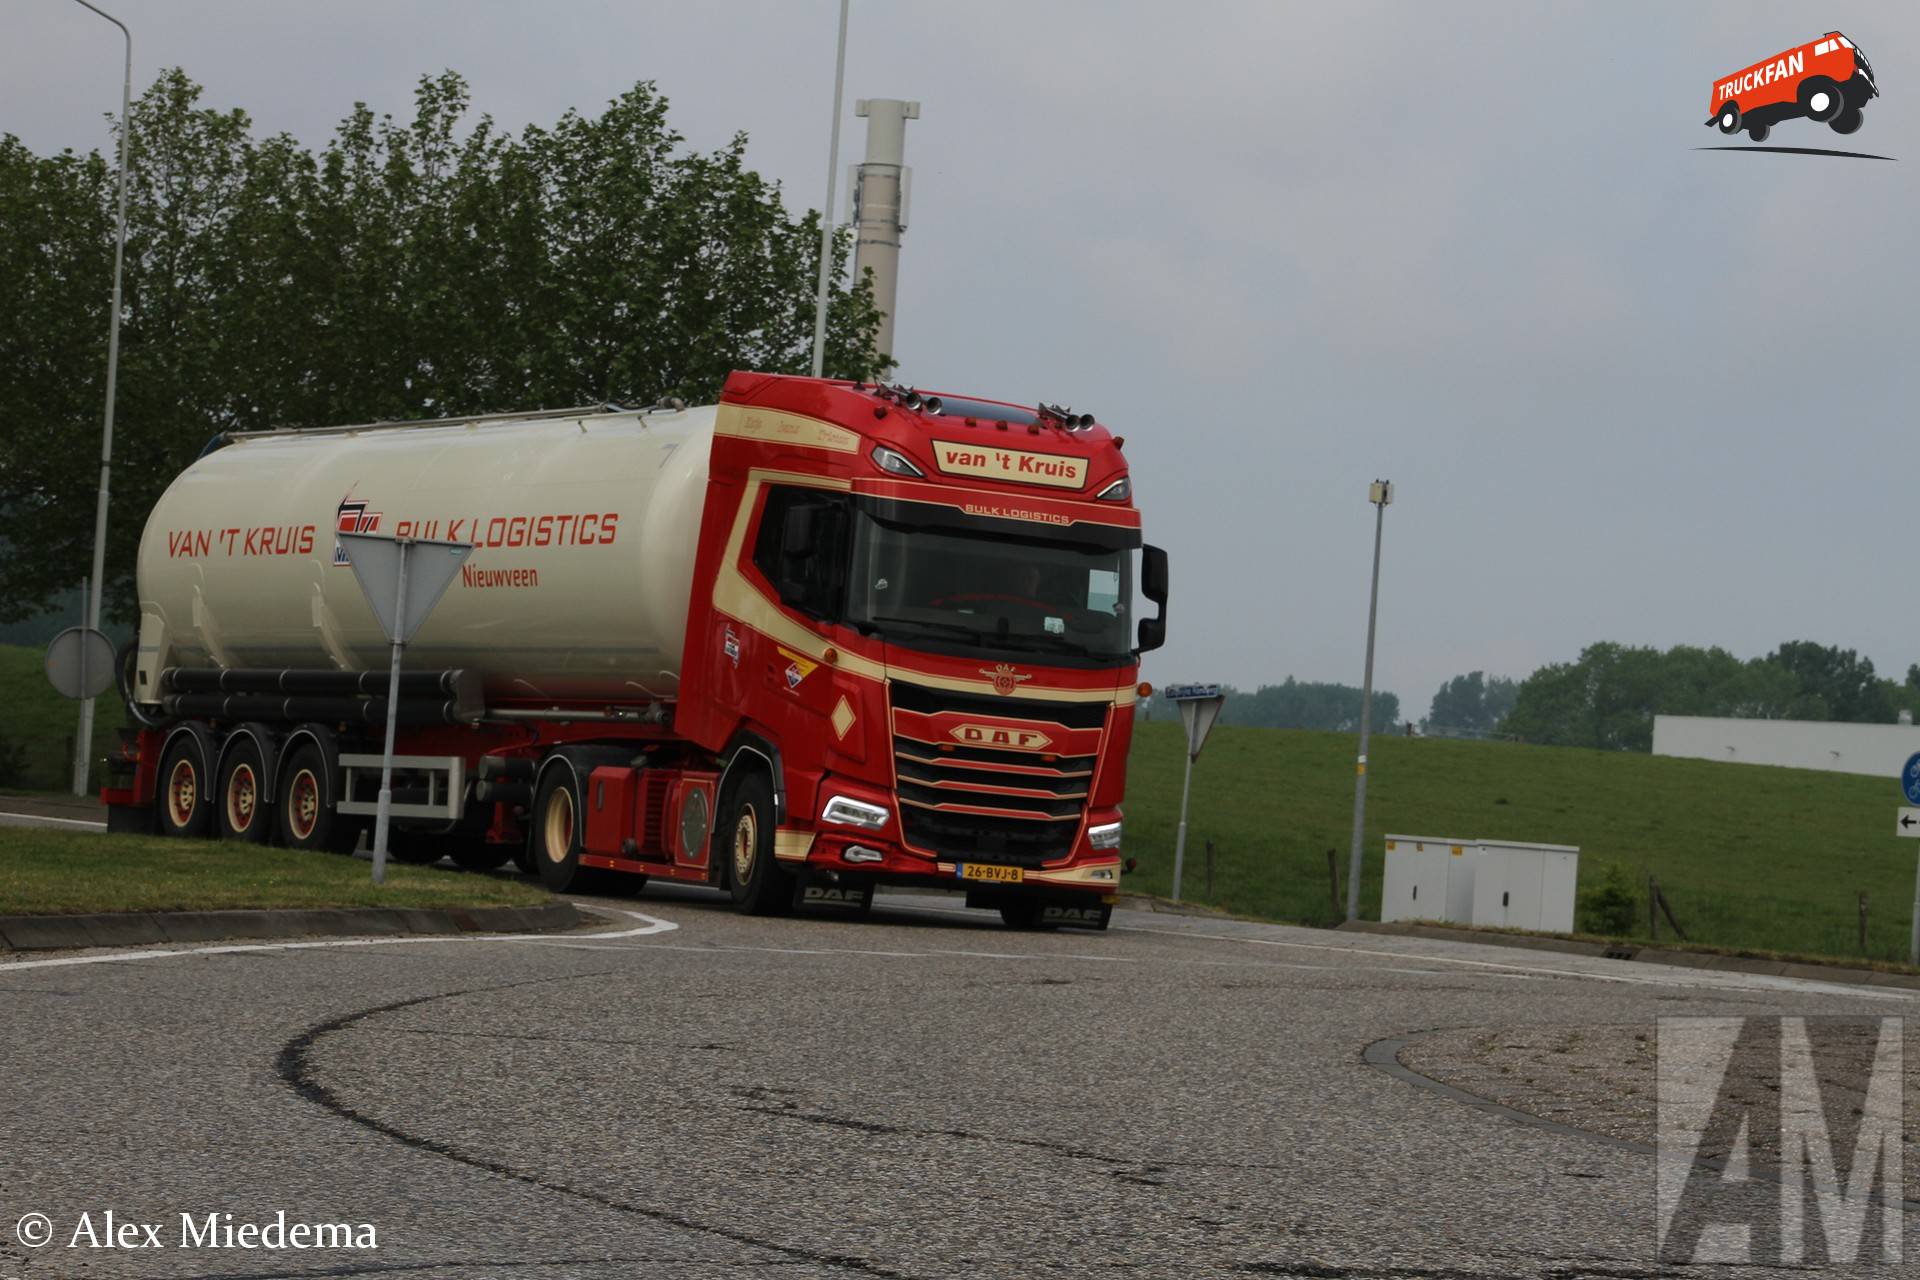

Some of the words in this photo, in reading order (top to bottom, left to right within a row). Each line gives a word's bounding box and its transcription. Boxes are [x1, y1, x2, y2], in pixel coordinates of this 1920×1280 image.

[946, 451, 986, 468] van
[996, 452, 1011, 470] 't
[1018, 455, 1077, 478] Kruis
[965, 504, 1000, 516] BULK
[1003, 509, 1069, 524] LOGISTICS
[470, 513, 619, 548] LOGISTICS
[168, 529, 212, 558] VAN
[219, 528, 241, 556] 'T
[243, 525, 316, 556] KRUIS
[462, 563, 539, 588] Nieuwveen
[964, 728, 1038, 747] DAF
[967, 865, 1019, 880] 26-BVJ-8
[804, 887, 865, 900] DAF
[1043, 907, 1102, 920] DAF
